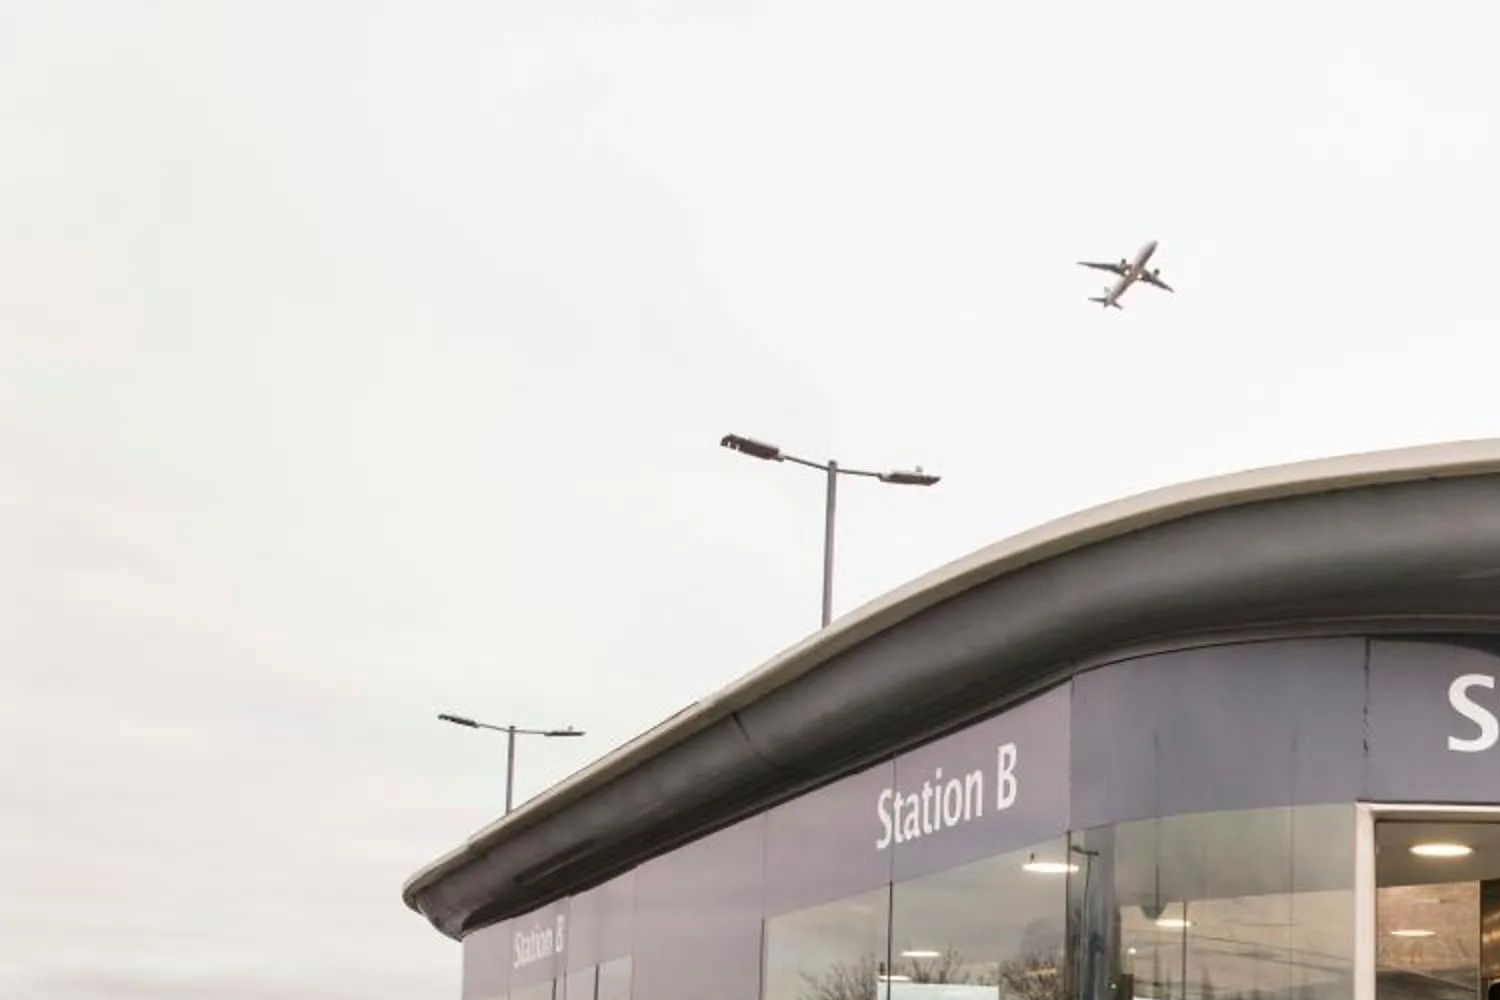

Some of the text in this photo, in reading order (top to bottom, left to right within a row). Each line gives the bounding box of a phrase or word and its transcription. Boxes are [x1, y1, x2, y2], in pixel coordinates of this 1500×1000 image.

[876, 742, 1018, 849] Station B
[513, 923, 553, 969] Station
